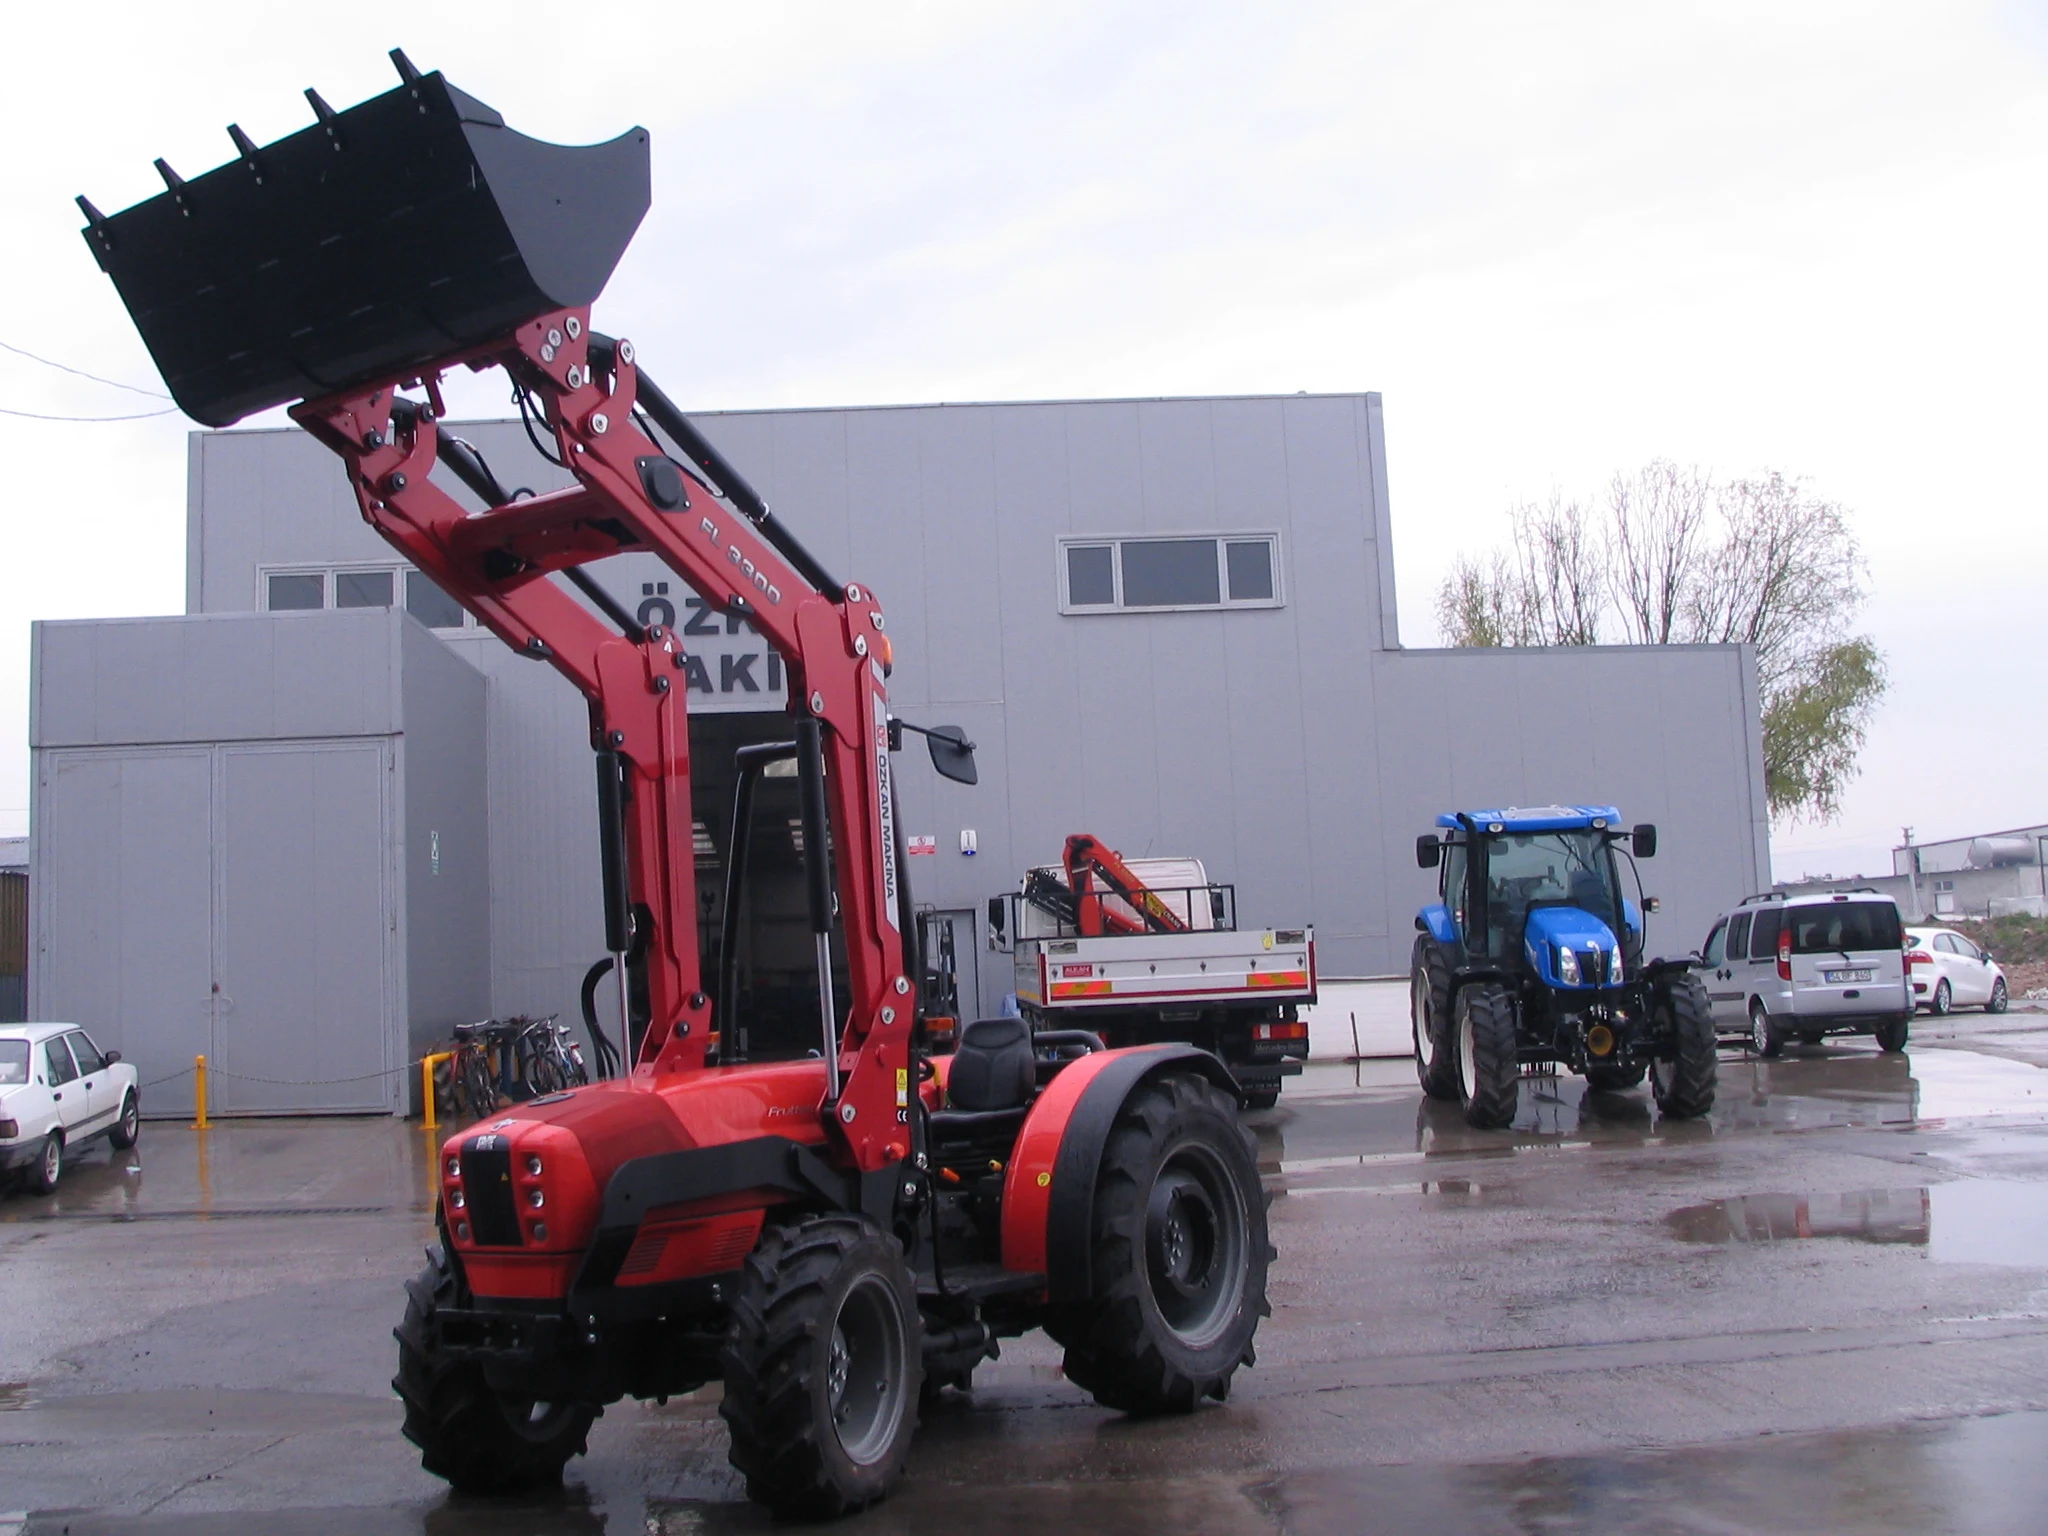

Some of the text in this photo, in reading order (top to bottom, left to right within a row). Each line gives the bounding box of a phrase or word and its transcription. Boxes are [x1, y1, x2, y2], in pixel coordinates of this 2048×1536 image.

[700, 517, 782, 605] FL 3300
[878, 755, 890, 819] ÖZKAN
[883, 825, 895, 899] MAKİNA
